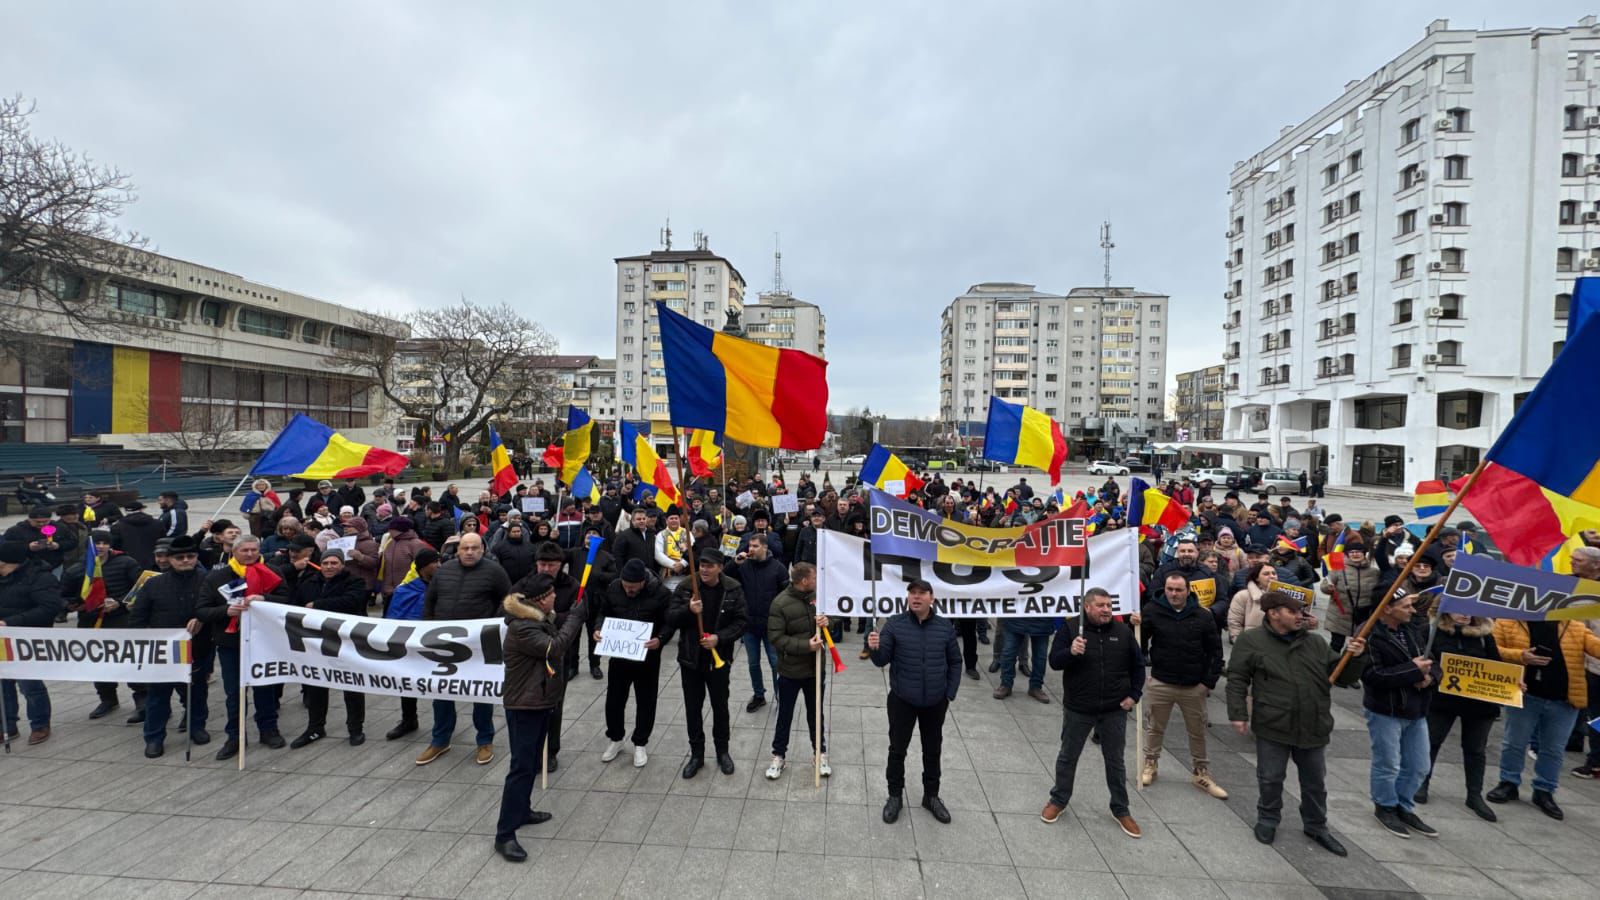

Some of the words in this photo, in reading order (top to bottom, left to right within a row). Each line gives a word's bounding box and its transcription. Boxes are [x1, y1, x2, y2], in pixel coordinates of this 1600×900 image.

[871, 505, 1085, 555] DEMOCRAȚIE
[837, 596, 854, 613] O
[862, 595, 1016, 614] COMNITATE
[1024, 594, 1121, 614] APARE
[635, 622, 650, 641] 2
[16, 638, 167, 670] DEMOCRAȚIE
[251, 661, 298, 679] CEEA
[301, 664, 320, 680] CE
[323, 667, 365, 687] VREM
[437, 678, 504, 698] PENTRU
[1446, 665, 1517, 685] DICTATURA!
